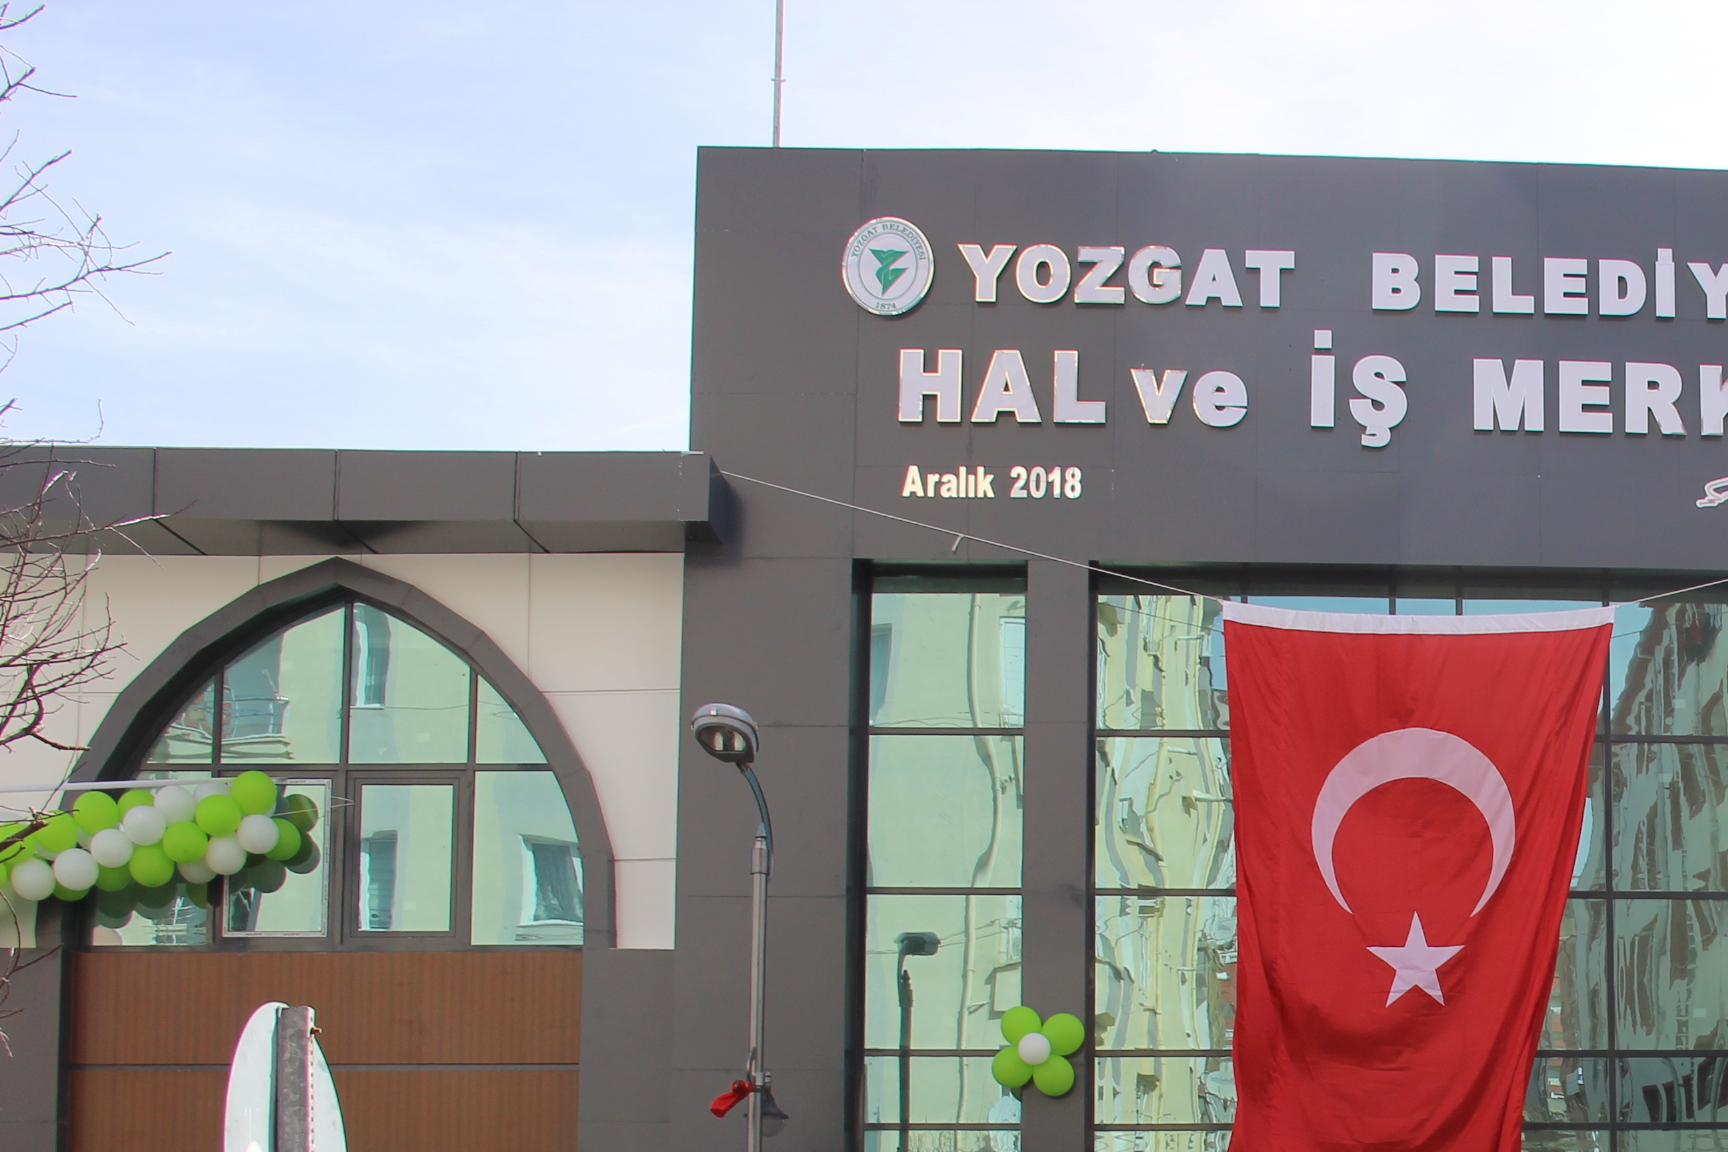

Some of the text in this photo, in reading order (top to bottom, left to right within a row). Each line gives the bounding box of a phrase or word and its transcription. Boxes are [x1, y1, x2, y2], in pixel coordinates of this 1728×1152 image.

[850, 226, 879, 259] YOZGAT
[957, 243, 1296, 308] YOZGAT
[875, 301, 897, 310] 1874
[897, 348, 1107, 425] HAL
[1130, 368, 1249, 428] ve
[1310, 329, 1409, 448] İŞ
[901, 465, 1083, 499] Aralık 2018
